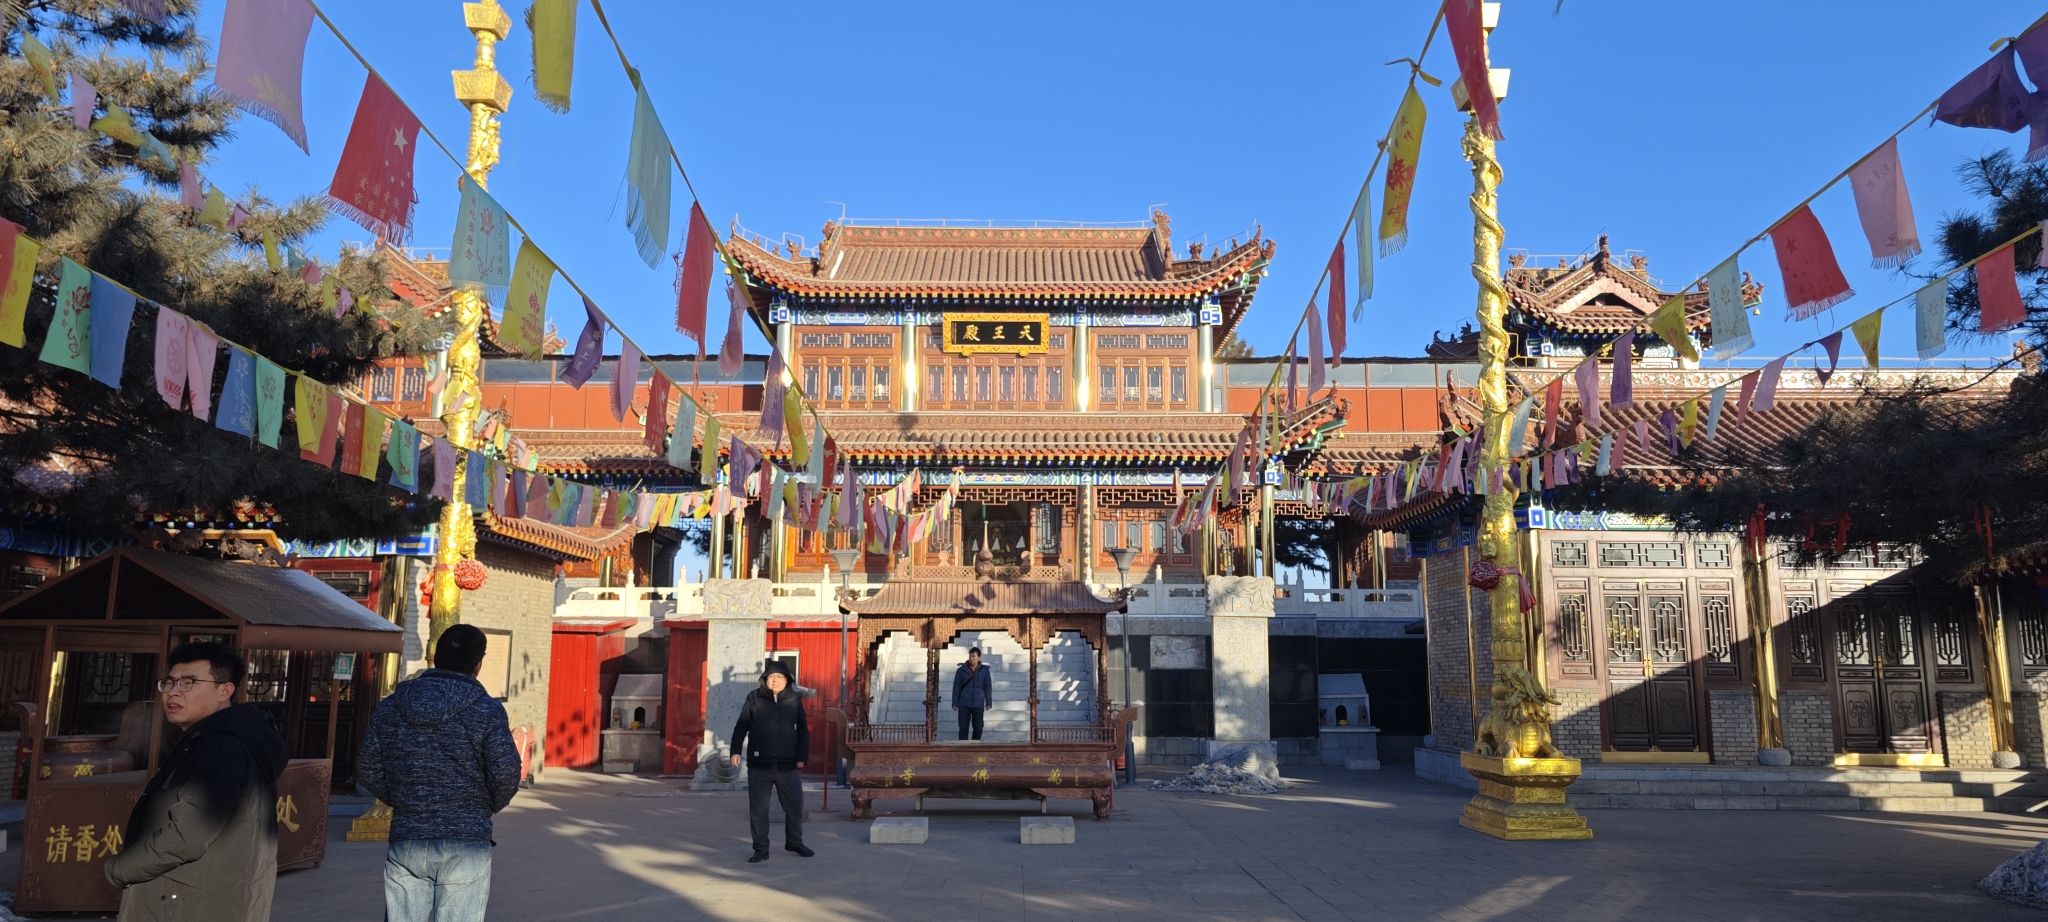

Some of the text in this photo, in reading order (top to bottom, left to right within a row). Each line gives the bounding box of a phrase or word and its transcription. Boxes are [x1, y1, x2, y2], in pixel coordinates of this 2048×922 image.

[963, 324, 1035, 342] 天王殿
[45, 824, 123, 864] 请香处
